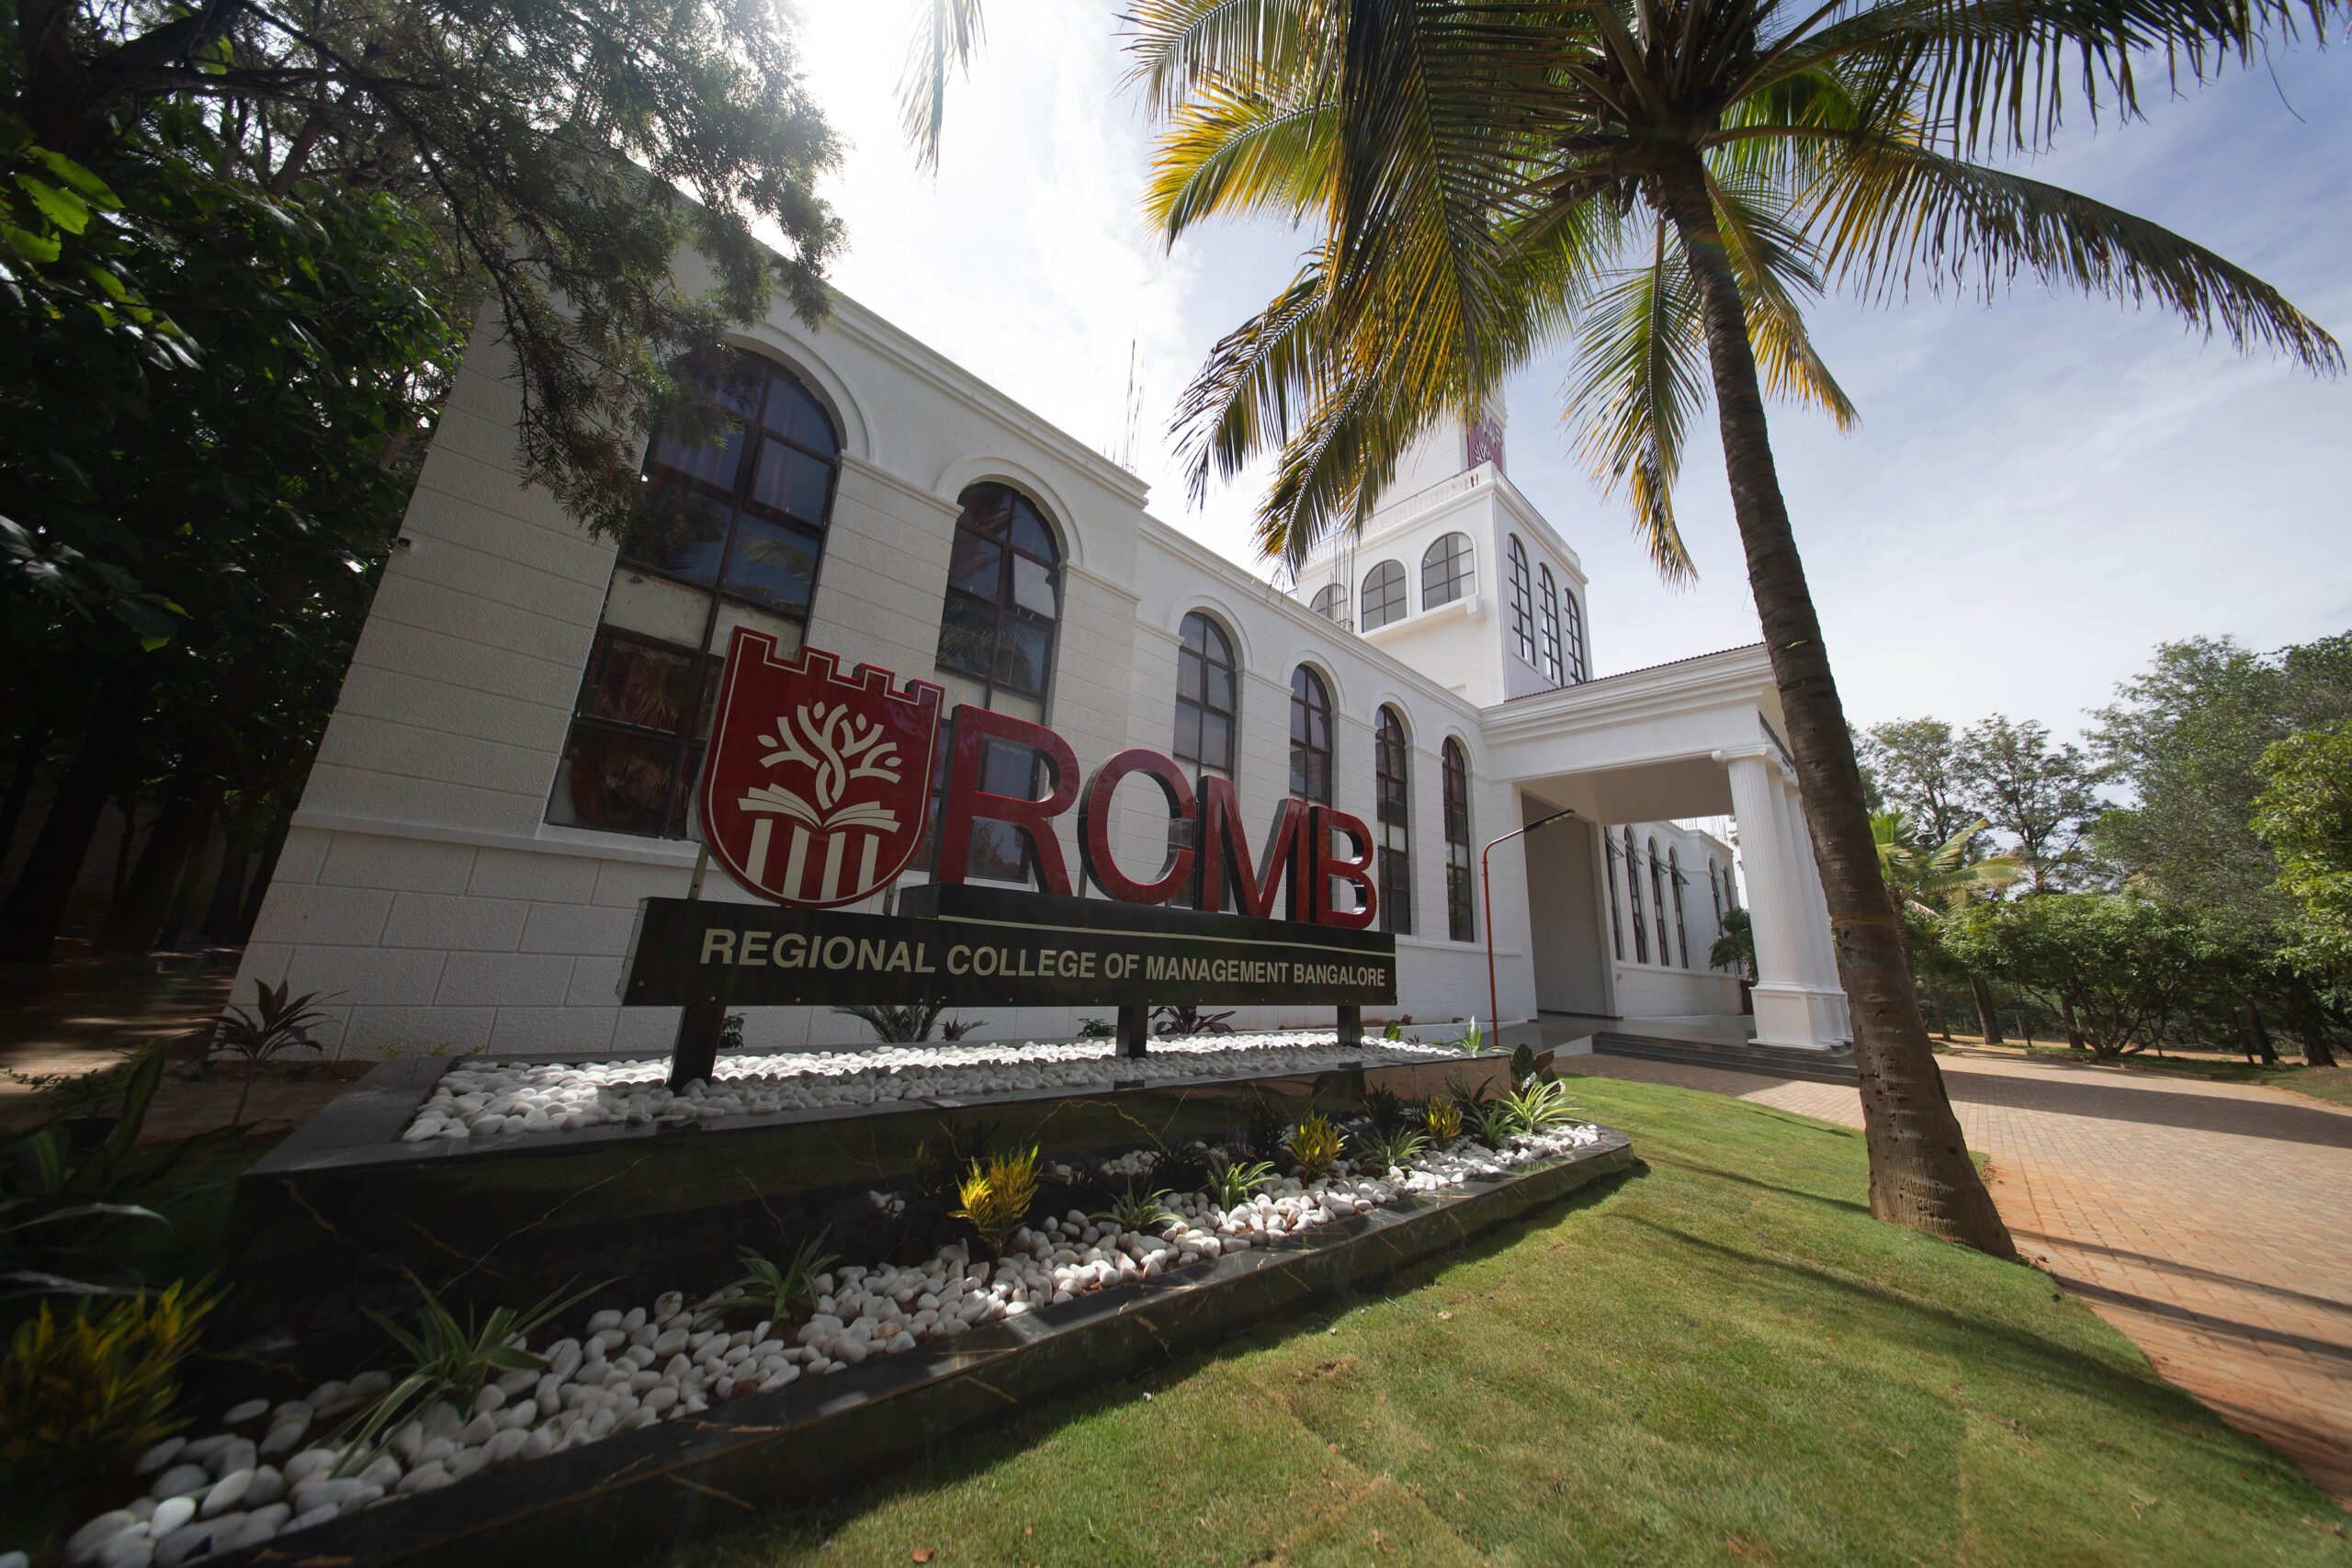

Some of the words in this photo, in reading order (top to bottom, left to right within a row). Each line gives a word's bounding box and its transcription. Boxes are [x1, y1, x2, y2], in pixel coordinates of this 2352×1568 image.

[931, 703, 1377, 930] RCMB
[699, 928, 936, 974] REGIONAL
[946, 944, 1097, 978] COLLEGE
[1104, 953, 1140, 979] OF
[1146, 955, 1289, 983] MANAGEMENT
[1294, 964, 1385, 987] BANGALORE
